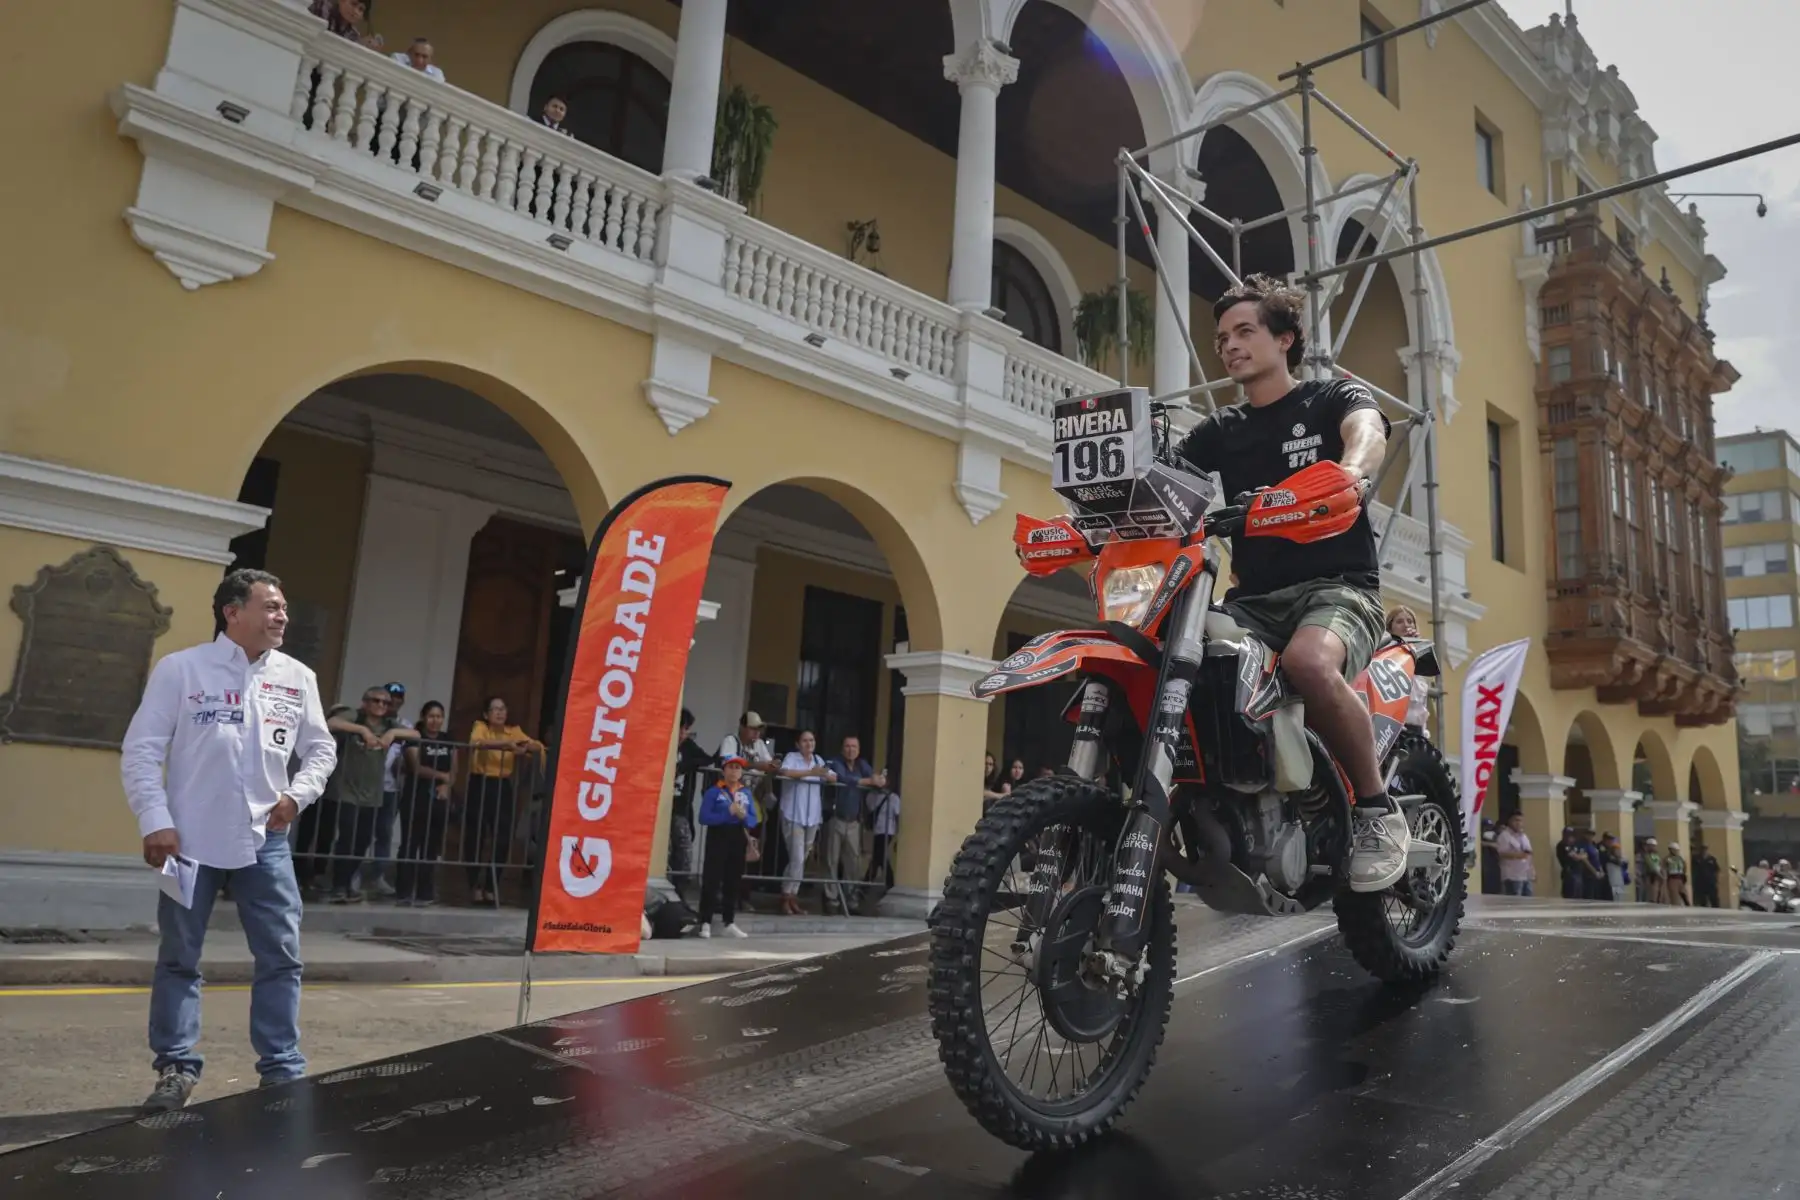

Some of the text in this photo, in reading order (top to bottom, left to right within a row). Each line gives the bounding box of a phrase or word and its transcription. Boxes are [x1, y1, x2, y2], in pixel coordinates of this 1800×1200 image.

[1055, 408, 1128, 440] RIVERA
[1282, 434, 1322, 454] RIVERA
[1055, 436, 1125, 483] 196
[1289, 448, 1318, 468] 374
[1073, 484, 1113, 497] Music
[1077, 489, 1125, 501] Market
[1262, 489, 1291, 501] Music
[1163, 484, 1194, 521] NUX
[1262, 497, 1295, 508] Market
[1260, 512, 1306, 526] ACERBIS
[1032, 527, 1064, 537] Music
[1032, 534, 1069, 543] Market
[1025, 548, 1073, 559] ACERBIS
[1369, 658, 1412, 701] 196
[559, 530, 666, 898] G GATORADE
[273, 728, 287, 745] G
[1376, 723, 1394, 757] aylor
[1127, 831, 1148, 842] usic
[1122, 840, 1153, 852] arket
